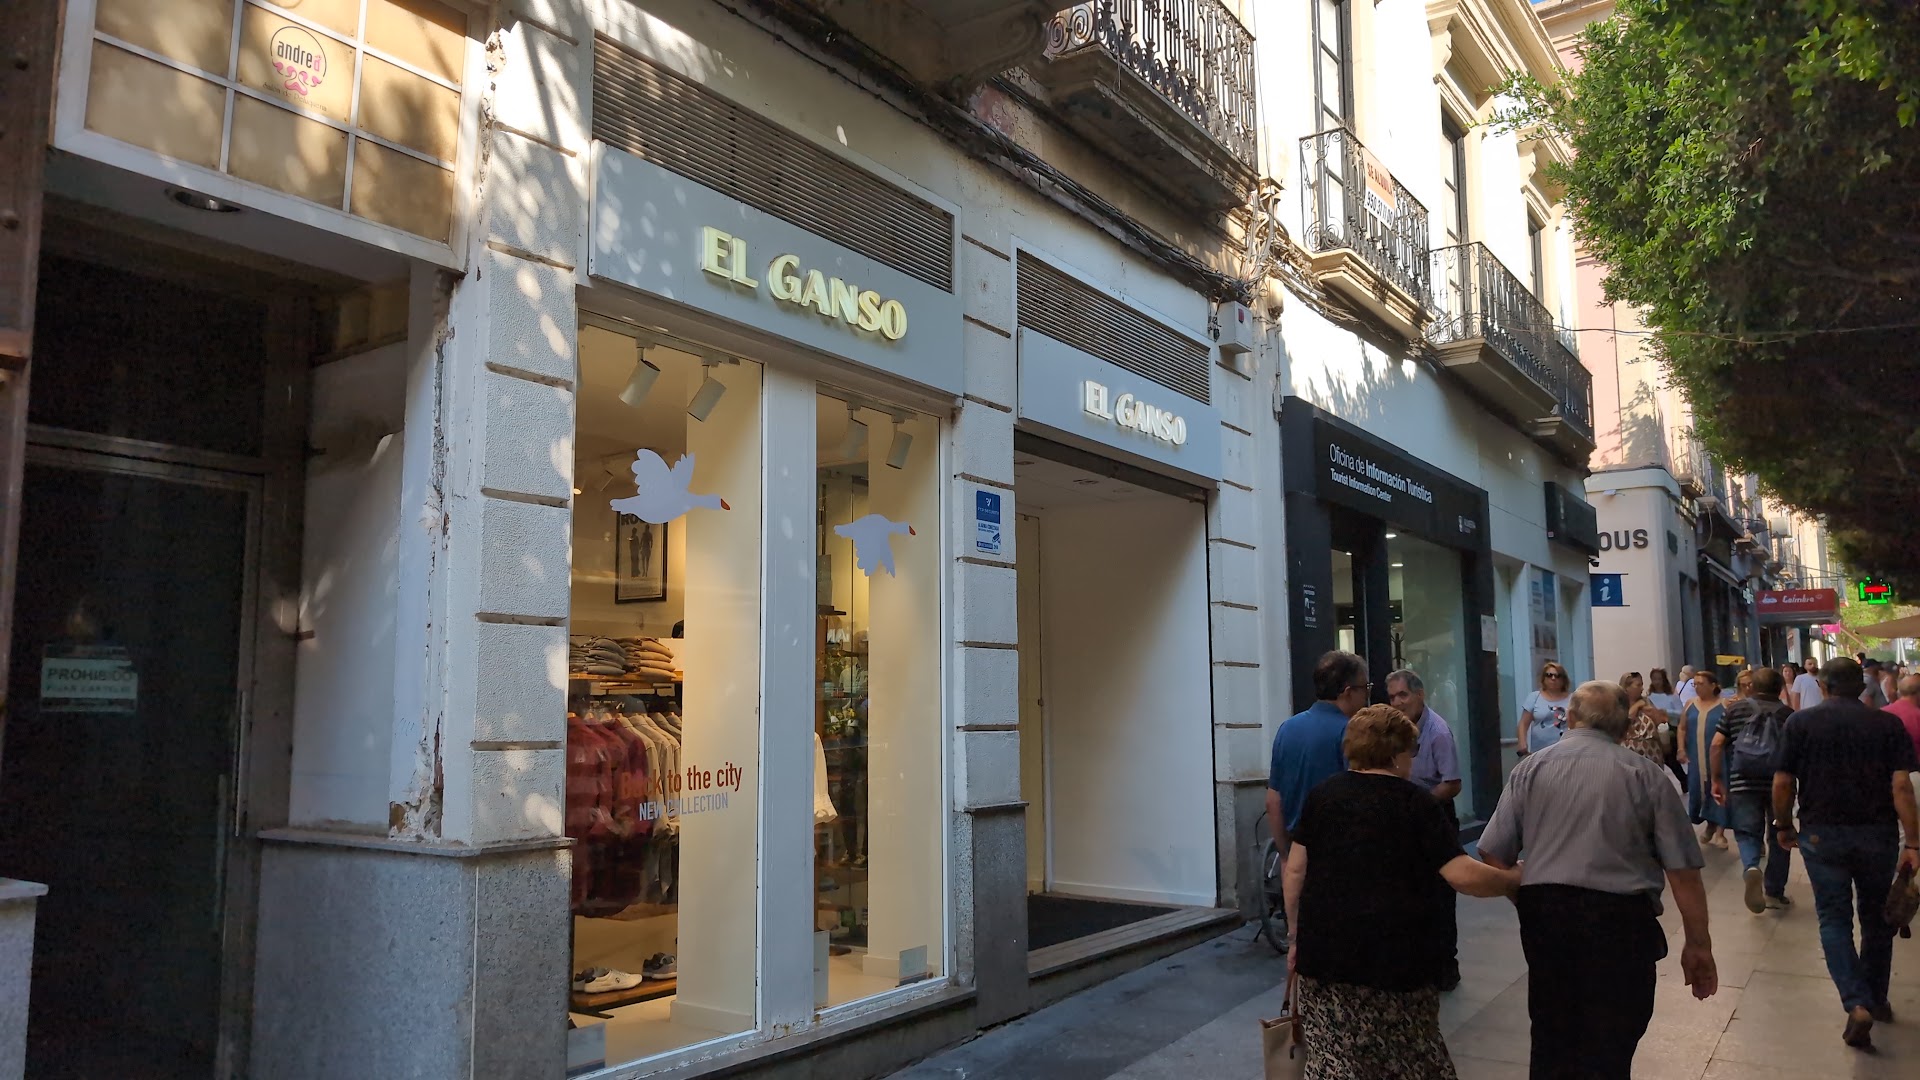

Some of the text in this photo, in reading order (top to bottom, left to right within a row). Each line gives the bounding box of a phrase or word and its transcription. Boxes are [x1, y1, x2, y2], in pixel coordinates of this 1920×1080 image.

[702, 226, 908, 340] EL GANSO
[1084, 380, 1187, 445] EL GANSO
[1329, 443, 1433, 504] Oficina de Información Turística
[1330, 467, 1392, 503] Tourist Information Center
[1599, 528, 1649, 552] OUS
[667, 769, 682, 793] to
[687, 765, 711, 791] the
[716, 761, 743, 792] city
[639, 801, 664, 822] NEW
